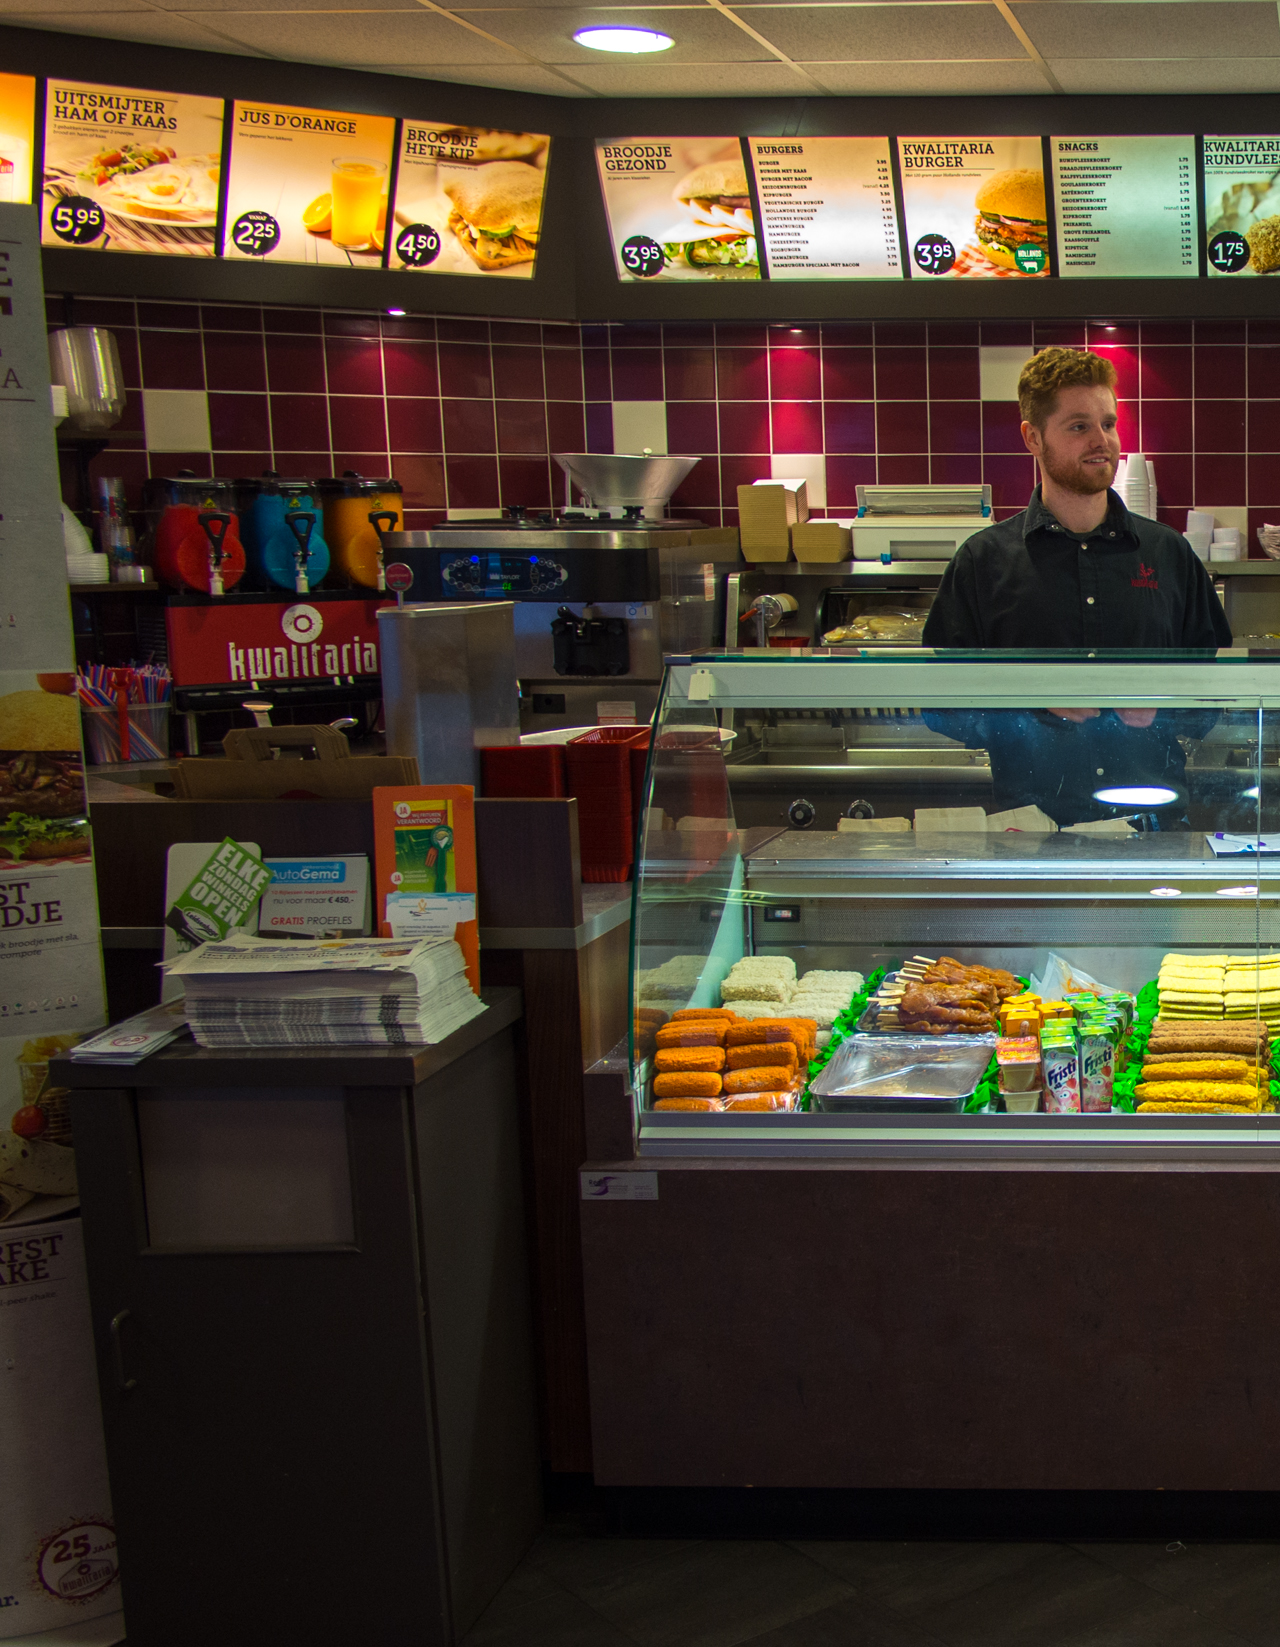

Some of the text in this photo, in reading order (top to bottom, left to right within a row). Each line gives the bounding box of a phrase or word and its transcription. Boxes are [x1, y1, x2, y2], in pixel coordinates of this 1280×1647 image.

[55, 91, 165, 114] UITSMIJTER
[54, 106, 177, 130] HAM OF KAAS
[240, 111, 356, 134] JUS D'ORANGE
[407, 129, 478, 148] BROODJE
[757, 146, 804, 154] BURGERS
[902, 144, 994, 155] KWALITARIA
[406, 142, 475, 160] HETE KIP
[603, 147, 672, 158] BROODJE
[904, 157, 964, 168] BURGER
[606, 159, 666, 170] GEZOND
[55, 207, 100, 236] 5,95
[237, 222, 274, 249] 2,25
[398, 234, 437, 260] 4,50
[624, 246, 660, 271] 3,95
[917, 244, 952, 269] 3,95
[1214, 242, 1244, 267] 1,75
[228, 636, 378, 681] kwalitaria
[399, 806, 408, 814] JA
[216, 843, 270, 891] ELKE
[273, 869, 339, 880] AutoGema
[202, 872, 250, 912] WINKELS
[208, 861, 257, 902] ZONDAG
[190, 882, 243, 927] OPEN
[271, 916, 352, 925] GRATIS PROEFLES
[8, 938, 44, 949] broodje
[46, 935, 63, 943] met
[1048, 1058, 1076, 1086] Fristi
[1084, 1046, 1112, 1075] Fristi
[53, 1534, 91, 1564] 25
